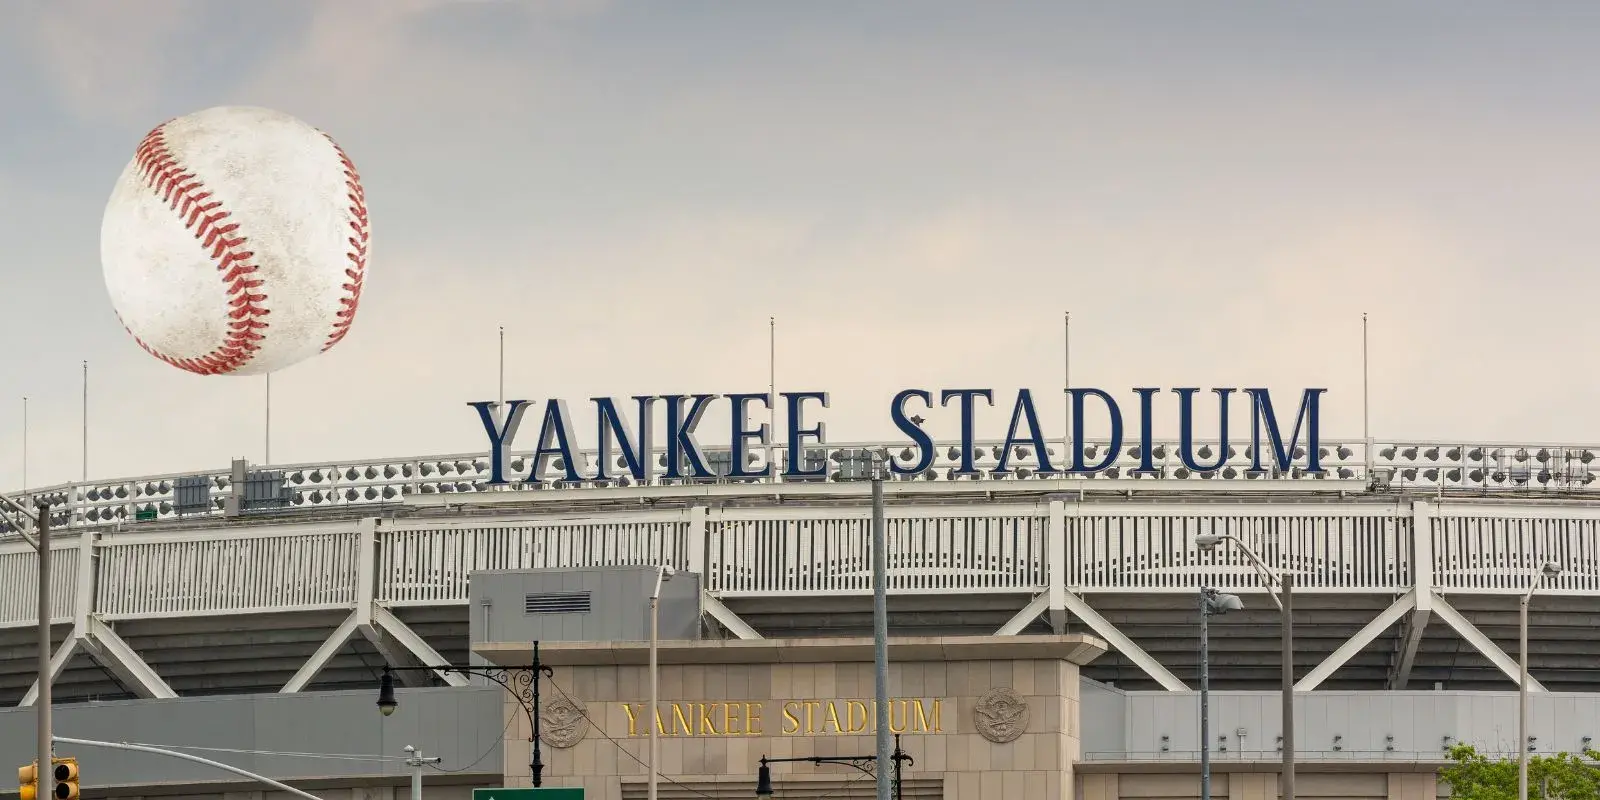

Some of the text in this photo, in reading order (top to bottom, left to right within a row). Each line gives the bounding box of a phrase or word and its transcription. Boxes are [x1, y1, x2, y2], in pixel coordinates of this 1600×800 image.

[467, 387, 1328, 485] YANKEE STADIUM
[622, 702, 763, 736] YANKEE
